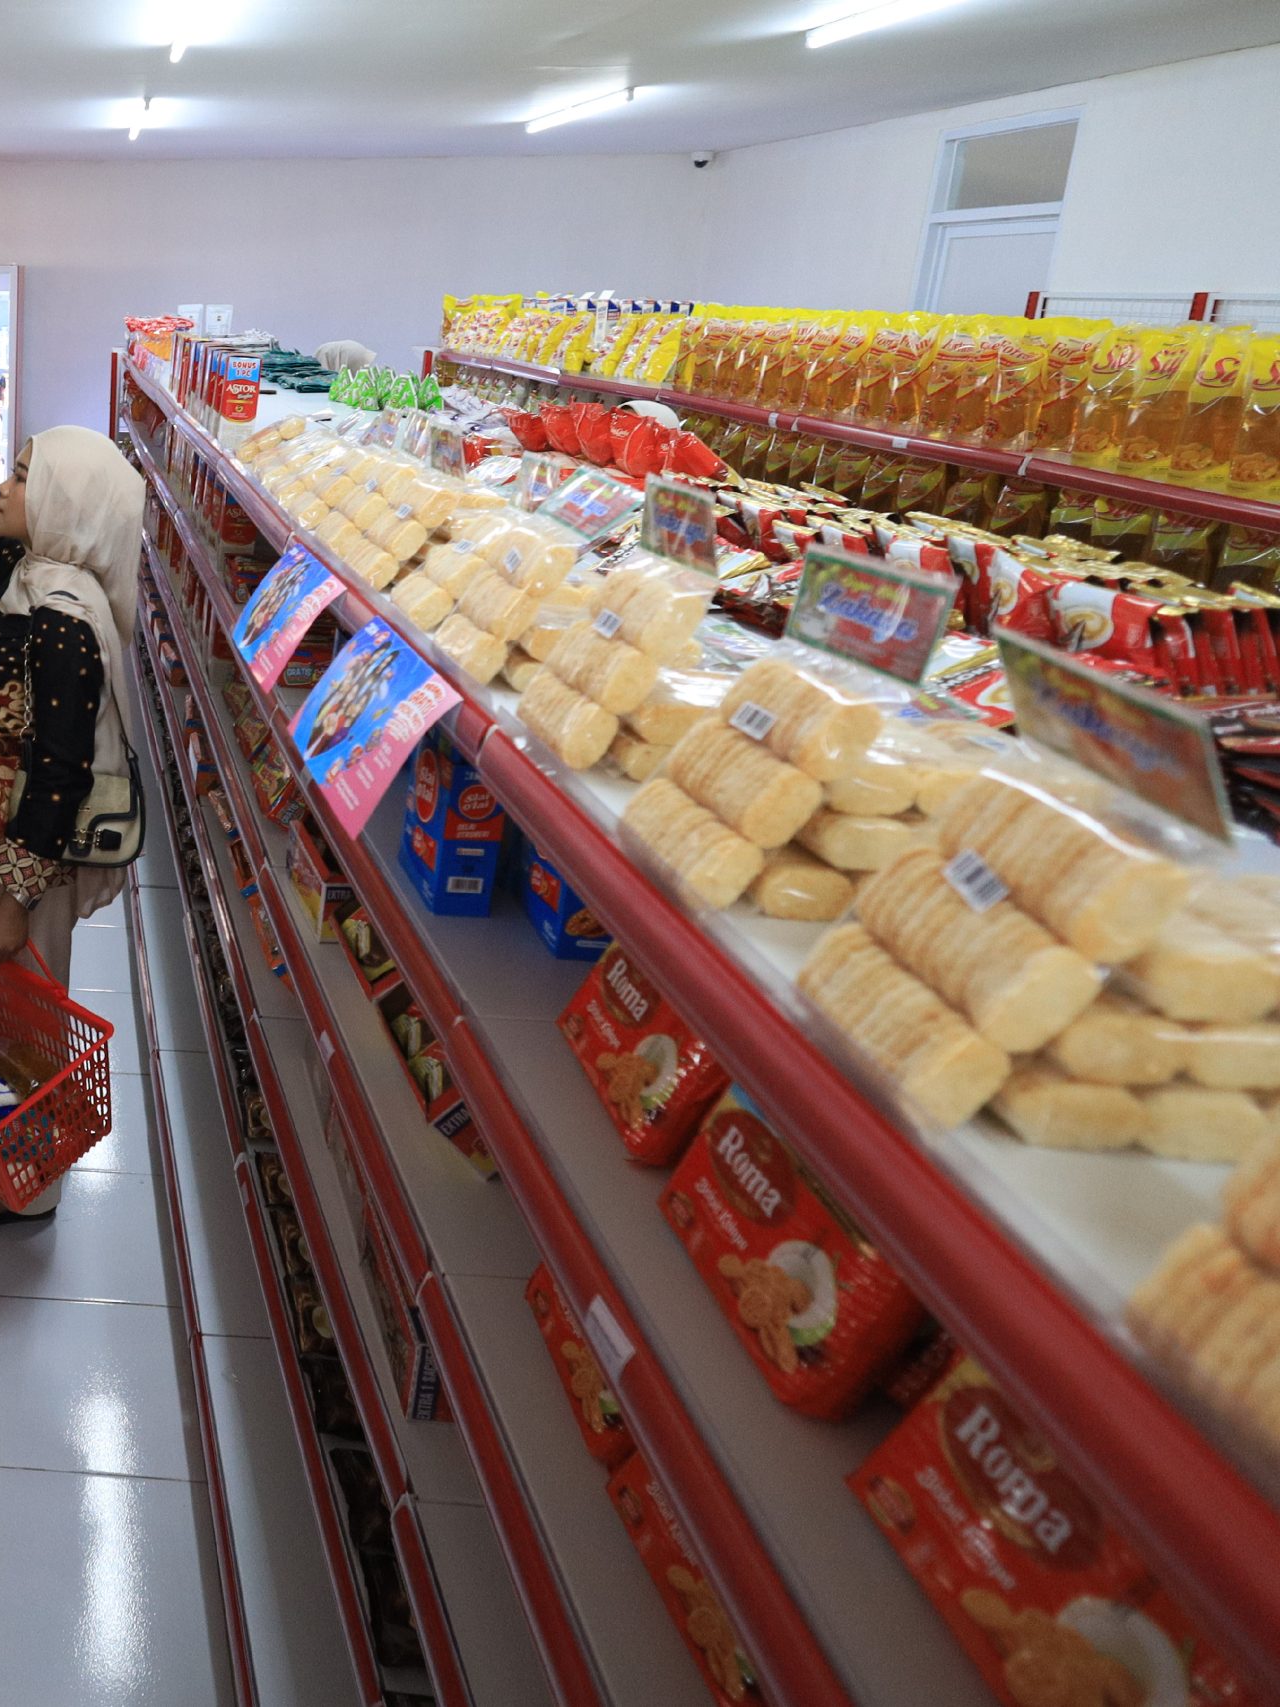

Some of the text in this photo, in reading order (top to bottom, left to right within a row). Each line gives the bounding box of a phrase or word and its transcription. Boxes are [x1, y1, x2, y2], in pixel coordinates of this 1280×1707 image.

[232, 361, 257, 369] BONUS
[226, 384, 257, 395] ASTOR
[604, 957, 650, 1022] Roma
[440, 1107, 470, 1137] EXTRA
[716, 1124, 784, 1220] Roma
[954, 1404, 1074, 1555] Roma
